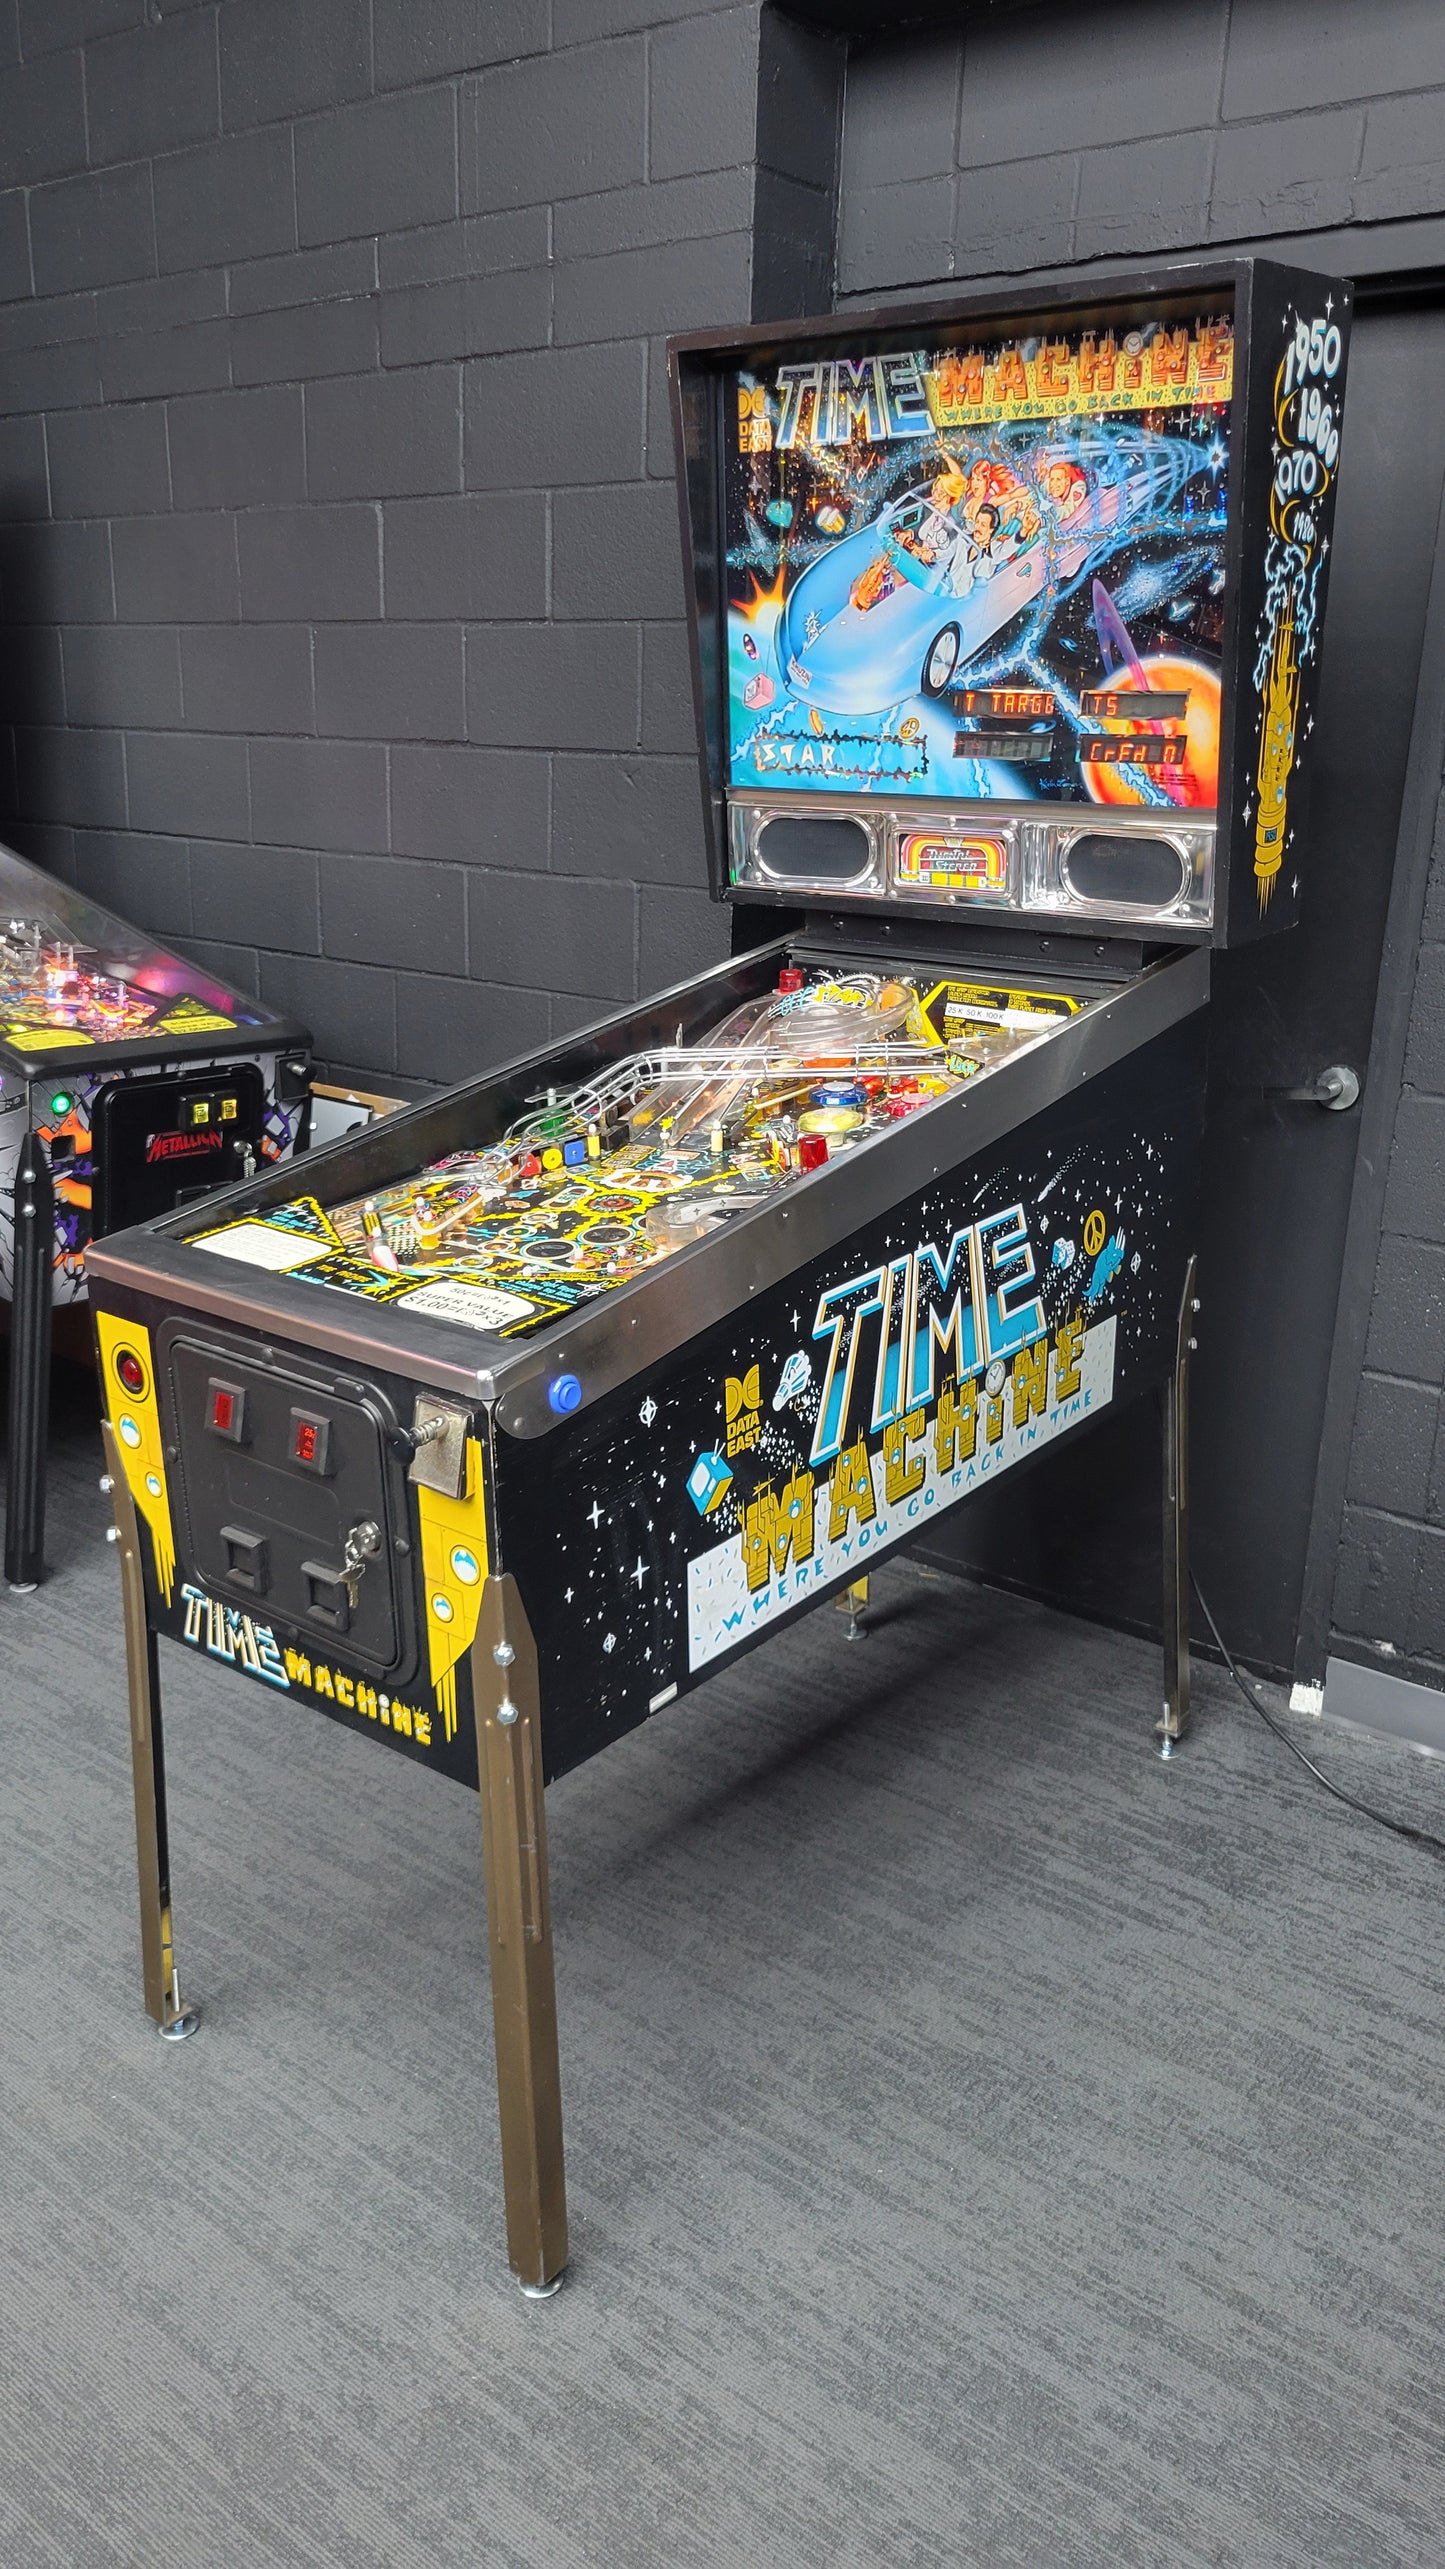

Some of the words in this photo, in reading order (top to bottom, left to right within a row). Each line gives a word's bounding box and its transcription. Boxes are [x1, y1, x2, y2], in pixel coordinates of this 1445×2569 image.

[1284, 319, 1342, 396] 1950
[775, 352, 936, 449] TIME
[1012, 402, 1045, 416] YOU
[1055, 399, 1078, 413] GO
[1087, 391, 1134, 409] BACK
[1146, 390, 1164, 402] IN
[1172, 385, 1216, 401] TIME
[739, 418, 772, 436] DATA
[1298, 388, 1338, 467] 1960
[739, 435, 772, 453] EAST
[1292, 511, 1314, 543] 1980
[762, 744, 836, 765] STAR
[947, 1006, 956, 1014] 25
[966, 1009, 976, 1017] 50
[986, 1011, 998, 1020] 100
[146, 1128, 223, 1163] METALLICA
[417, 1290, 463, 1305] SUPER
[467, 1301, 514, 1318] VALUE
[809, 1203, 1047, 1467] TIME
[727, 1411, 760, 1440] DATA
[727, 1426, 762, 1458] EAST
[722, 1556, 824, 1631] WHERE
[841, 1520, 888, 1558] YOU
[907, 1488, 935, 1517] GO
[951, 1446, 1004, 1488] BACK
[1020, 1426, 1037, 1447] IN
[1050, 1389, 1092, 1425] TIME
[180, 1583, 291, 1689] TIME
